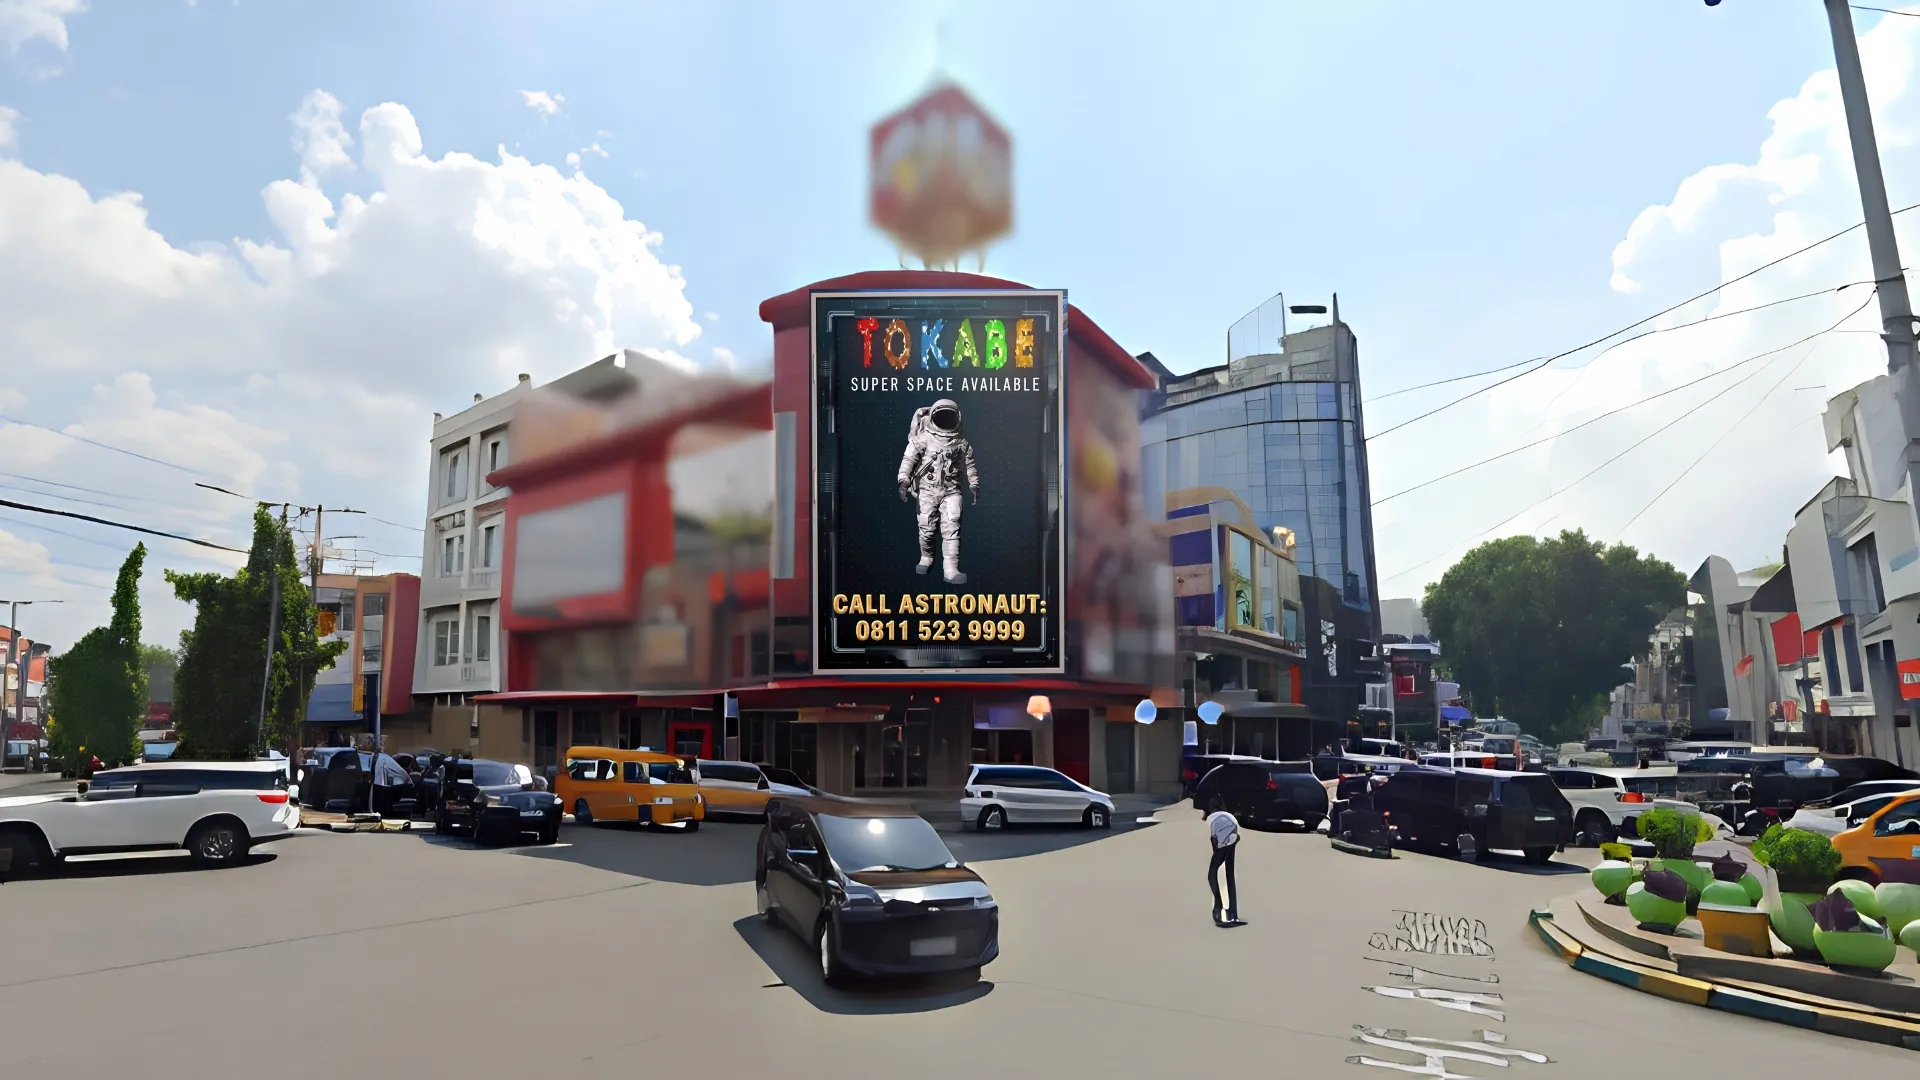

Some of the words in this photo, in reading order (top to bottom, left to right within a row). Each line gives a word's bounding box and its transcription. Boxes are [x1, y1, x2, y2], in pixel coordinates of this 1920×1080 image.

[857, 317, 1035, 370] TOKABE
[851, 377, 899, 392] SUPER
[907, 377, 954, 392] SPACE
[961, 377, 1040, 392] AVAILABLE
[833, 594, 891, 615] CALL
[899, 594, 1047, 615] ASTRONAUT:
[856, 620, 909, 641] 0811
[918, 620, 960, 641] 523
[968, 620, 1025, 641] 9999
